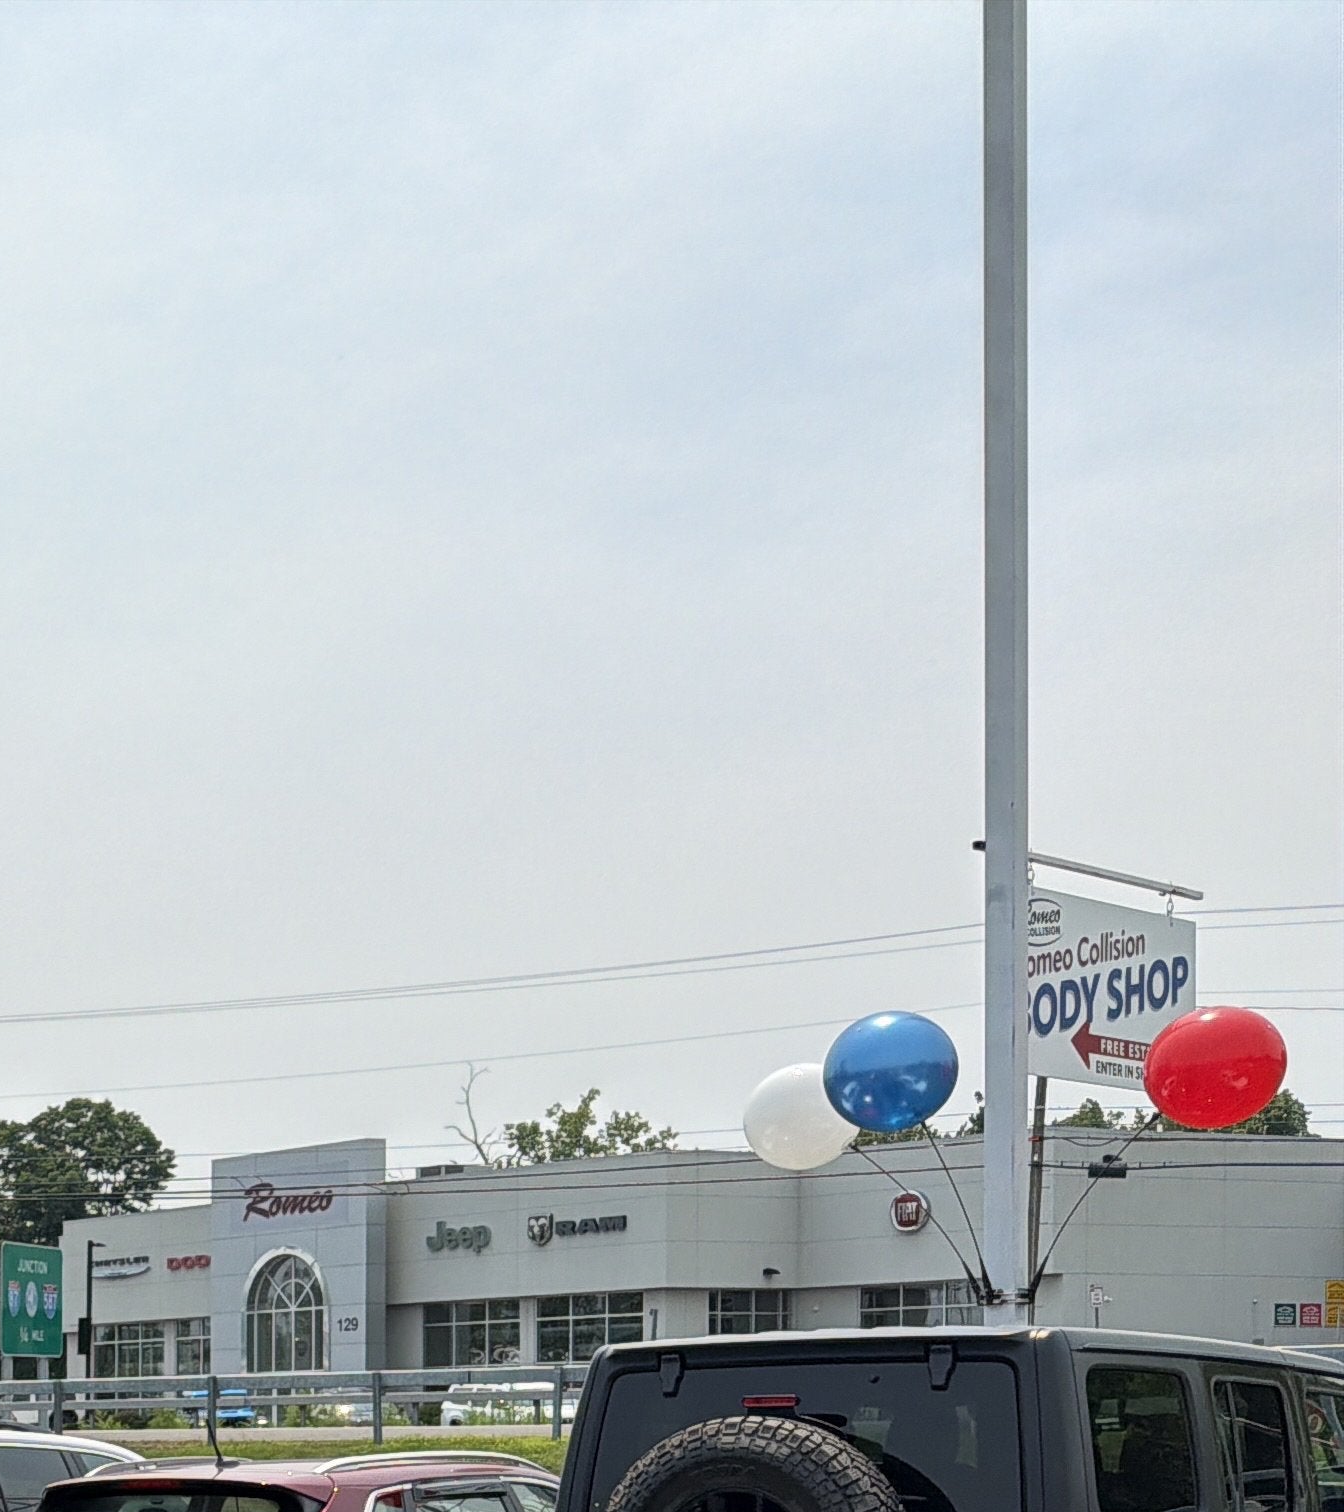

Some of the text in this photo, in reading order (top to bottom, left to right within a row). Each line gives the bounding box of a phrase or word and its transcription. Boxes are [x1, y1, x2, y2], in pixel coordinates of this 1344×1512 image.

[1028, 901, 1061, 926] omeo
[1028, 929, 1146, 978] omeo Collision
[1028, 956, 1190, 1038] ODY SHOP
[1100, 1038, 1150, 1060] FREE EST
[1095, 1060, 1123, 1077] ENTER
[1124, 1064, 1134, 1079] IN
[243, 1182, 333, 1222] Romeo
[555, 1215, 628, 1237] RAM
[426, 1220, 492, 1256] Jeep
[17, 1258, 48, 1275] JUNCTION
[337, 1317, 359, 1332] 129
